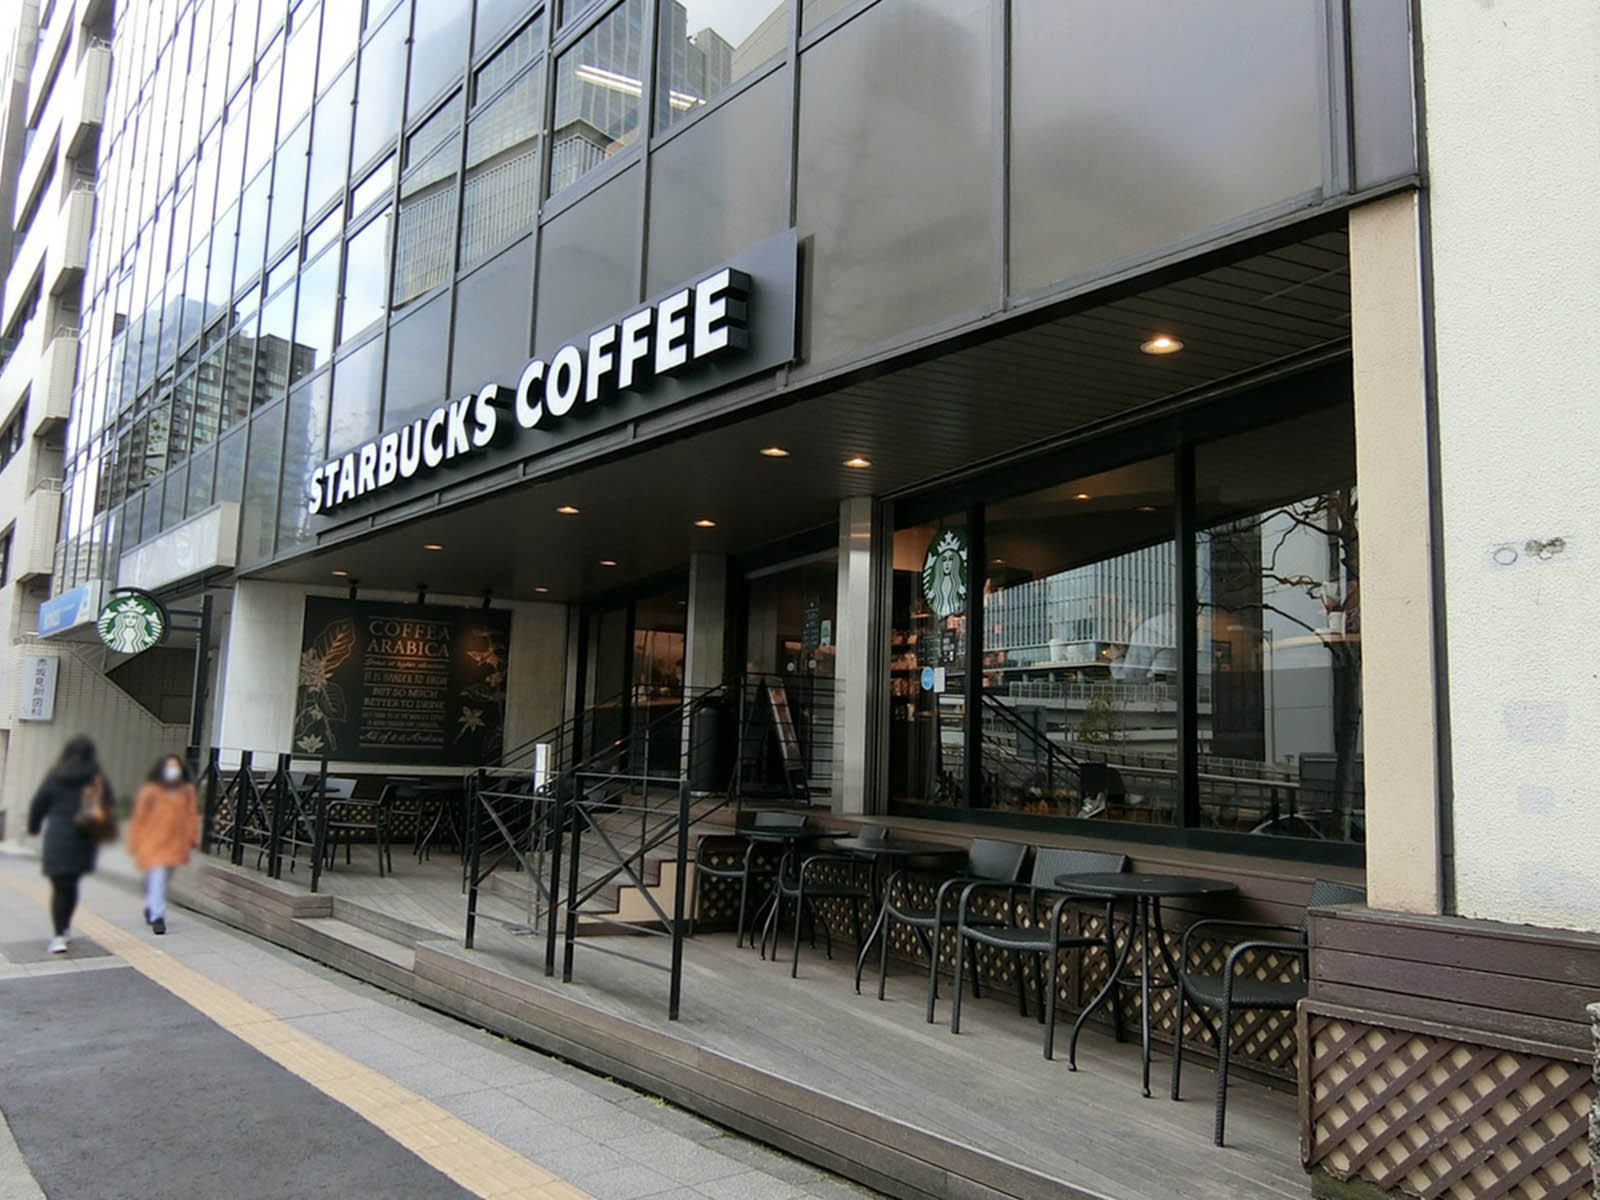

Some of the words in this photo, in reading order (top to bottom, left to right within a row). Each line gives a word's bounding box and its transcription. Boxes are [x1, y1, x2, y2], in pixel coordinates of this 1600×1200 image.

[307, 382, 499, 516] STARBUCKS
[514, 266, 735, 430] COFFEE
[368, 620, 450, 641] COFFEA
[367, 638, 450, 657] ARABICA
